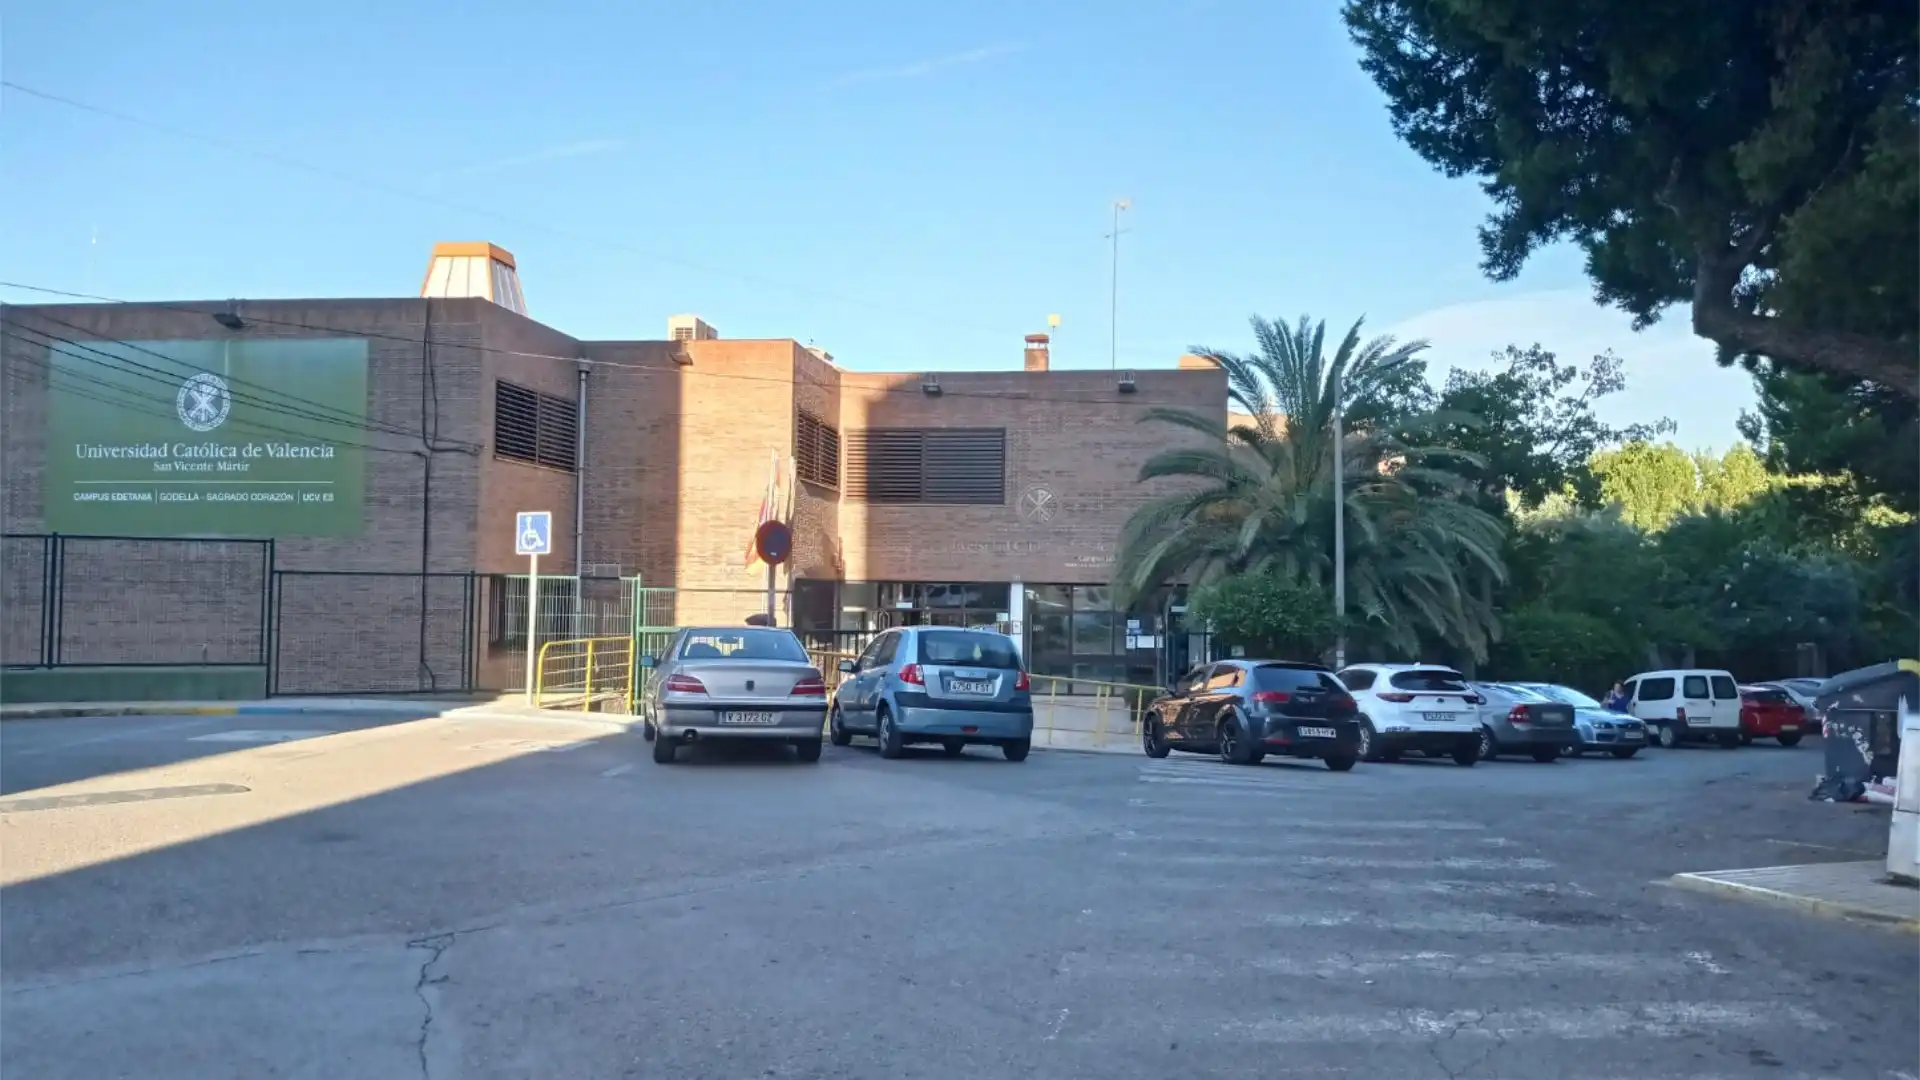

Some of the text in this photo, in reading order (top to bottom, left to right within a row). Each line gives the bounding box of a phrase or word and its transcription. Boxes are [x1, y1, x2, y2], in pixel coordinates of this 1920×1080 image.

[76, 442, 335, 459] Universidad Católica de Valencia
[153, 461, 172, 471] San
[174, 461, 213, 471] Vicente
[73, 492, 152, 501] CAMPUS EDETANIA
[160, 492, 199, 501] GODELLA
[206, 492, 249, 501] SAGRADO
[251, 491, 294, 501] CORAZÓN
